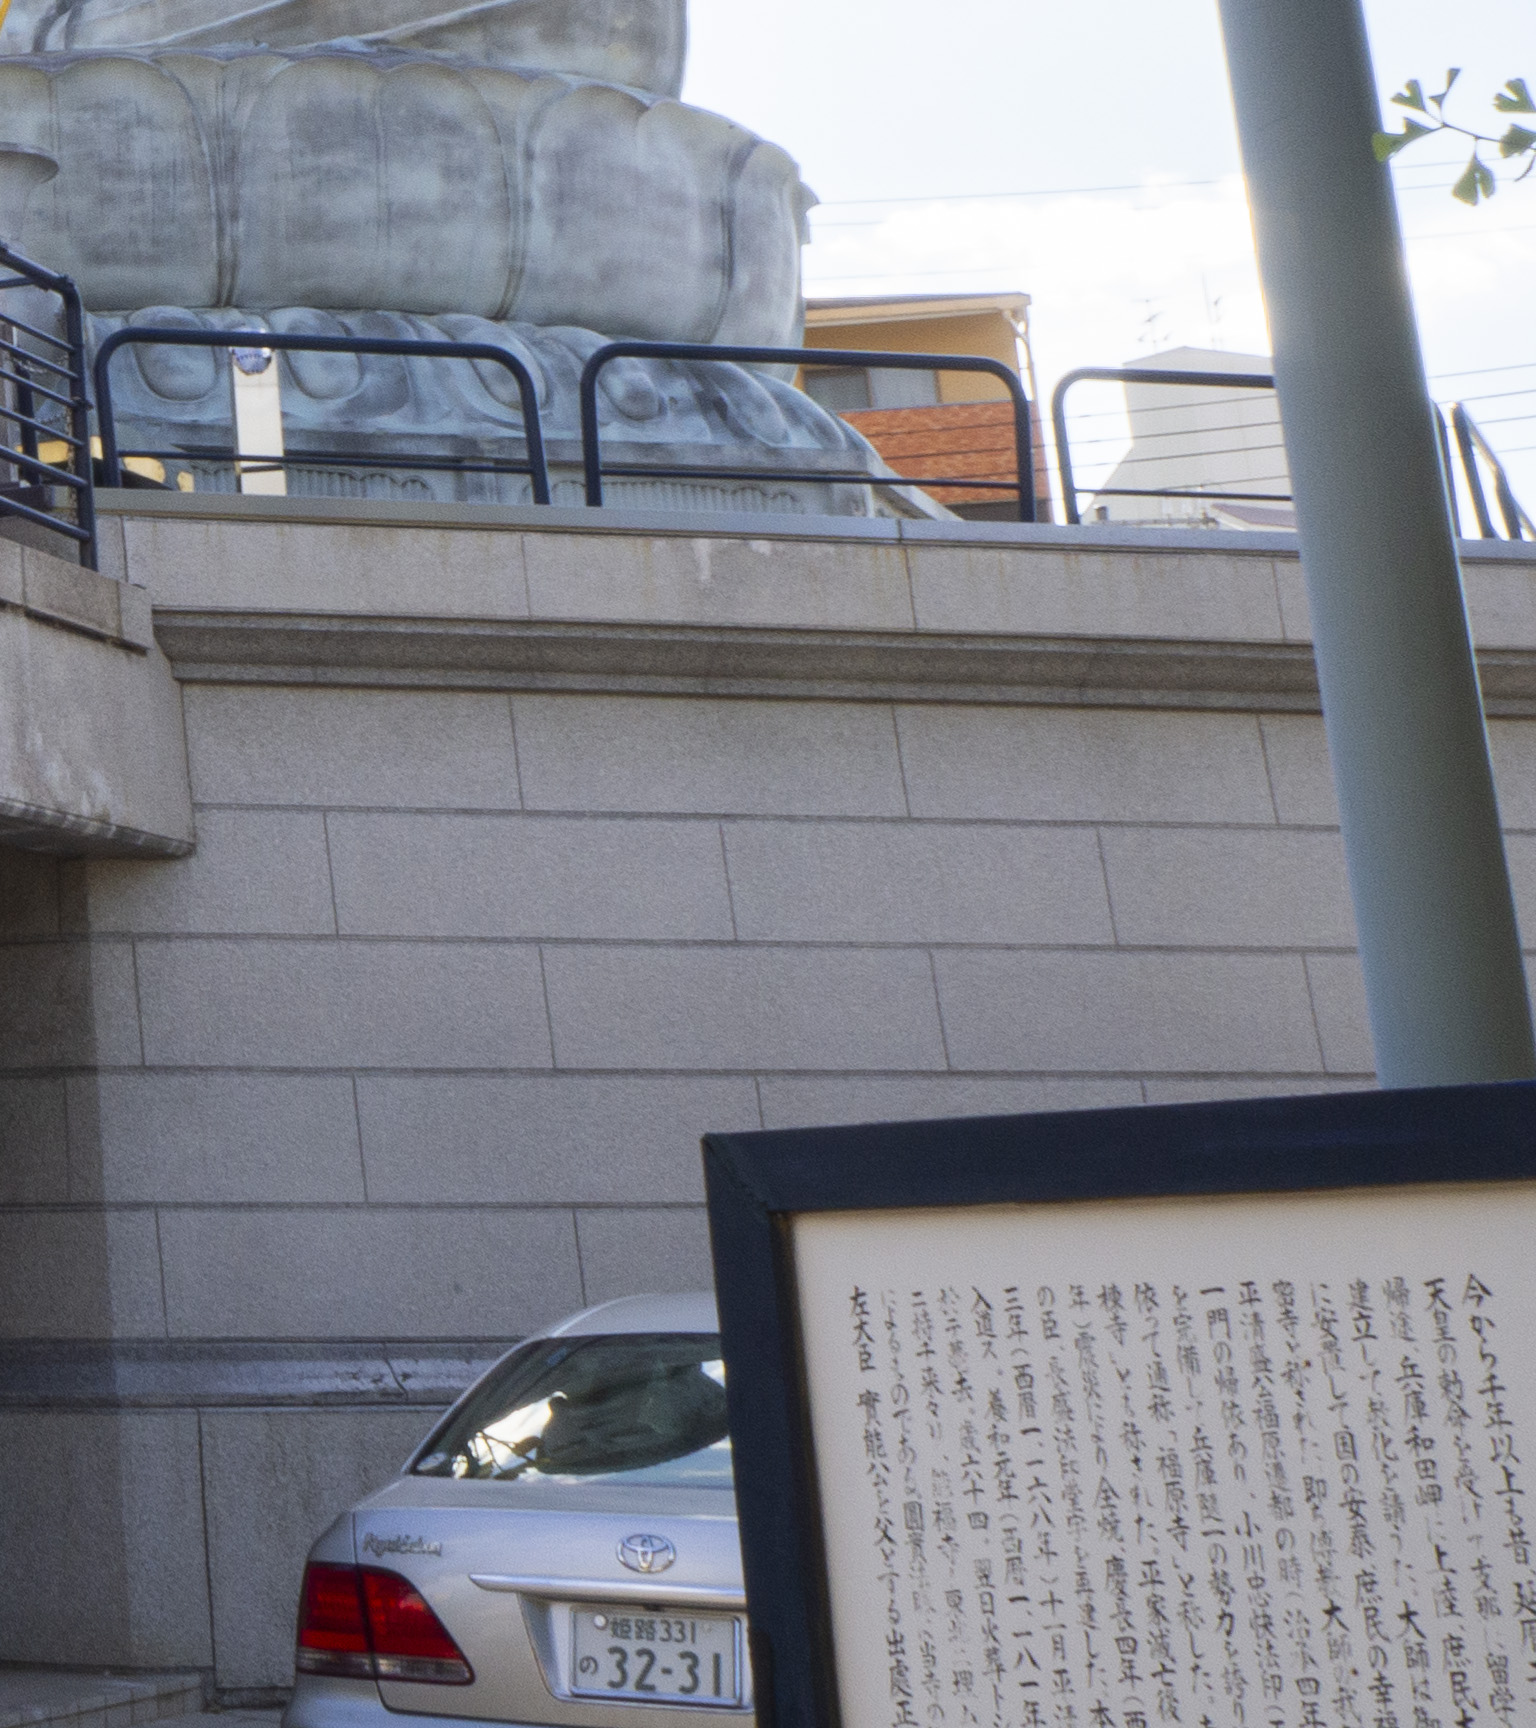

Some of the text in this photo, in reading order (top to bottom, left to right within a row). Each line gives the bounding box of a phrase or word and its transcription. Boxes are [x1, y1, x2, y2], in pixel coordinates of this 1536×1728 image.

[610, 1618, 698, 1645] 姫路 331
[580, 1645, 723, 1697] の 32-31
